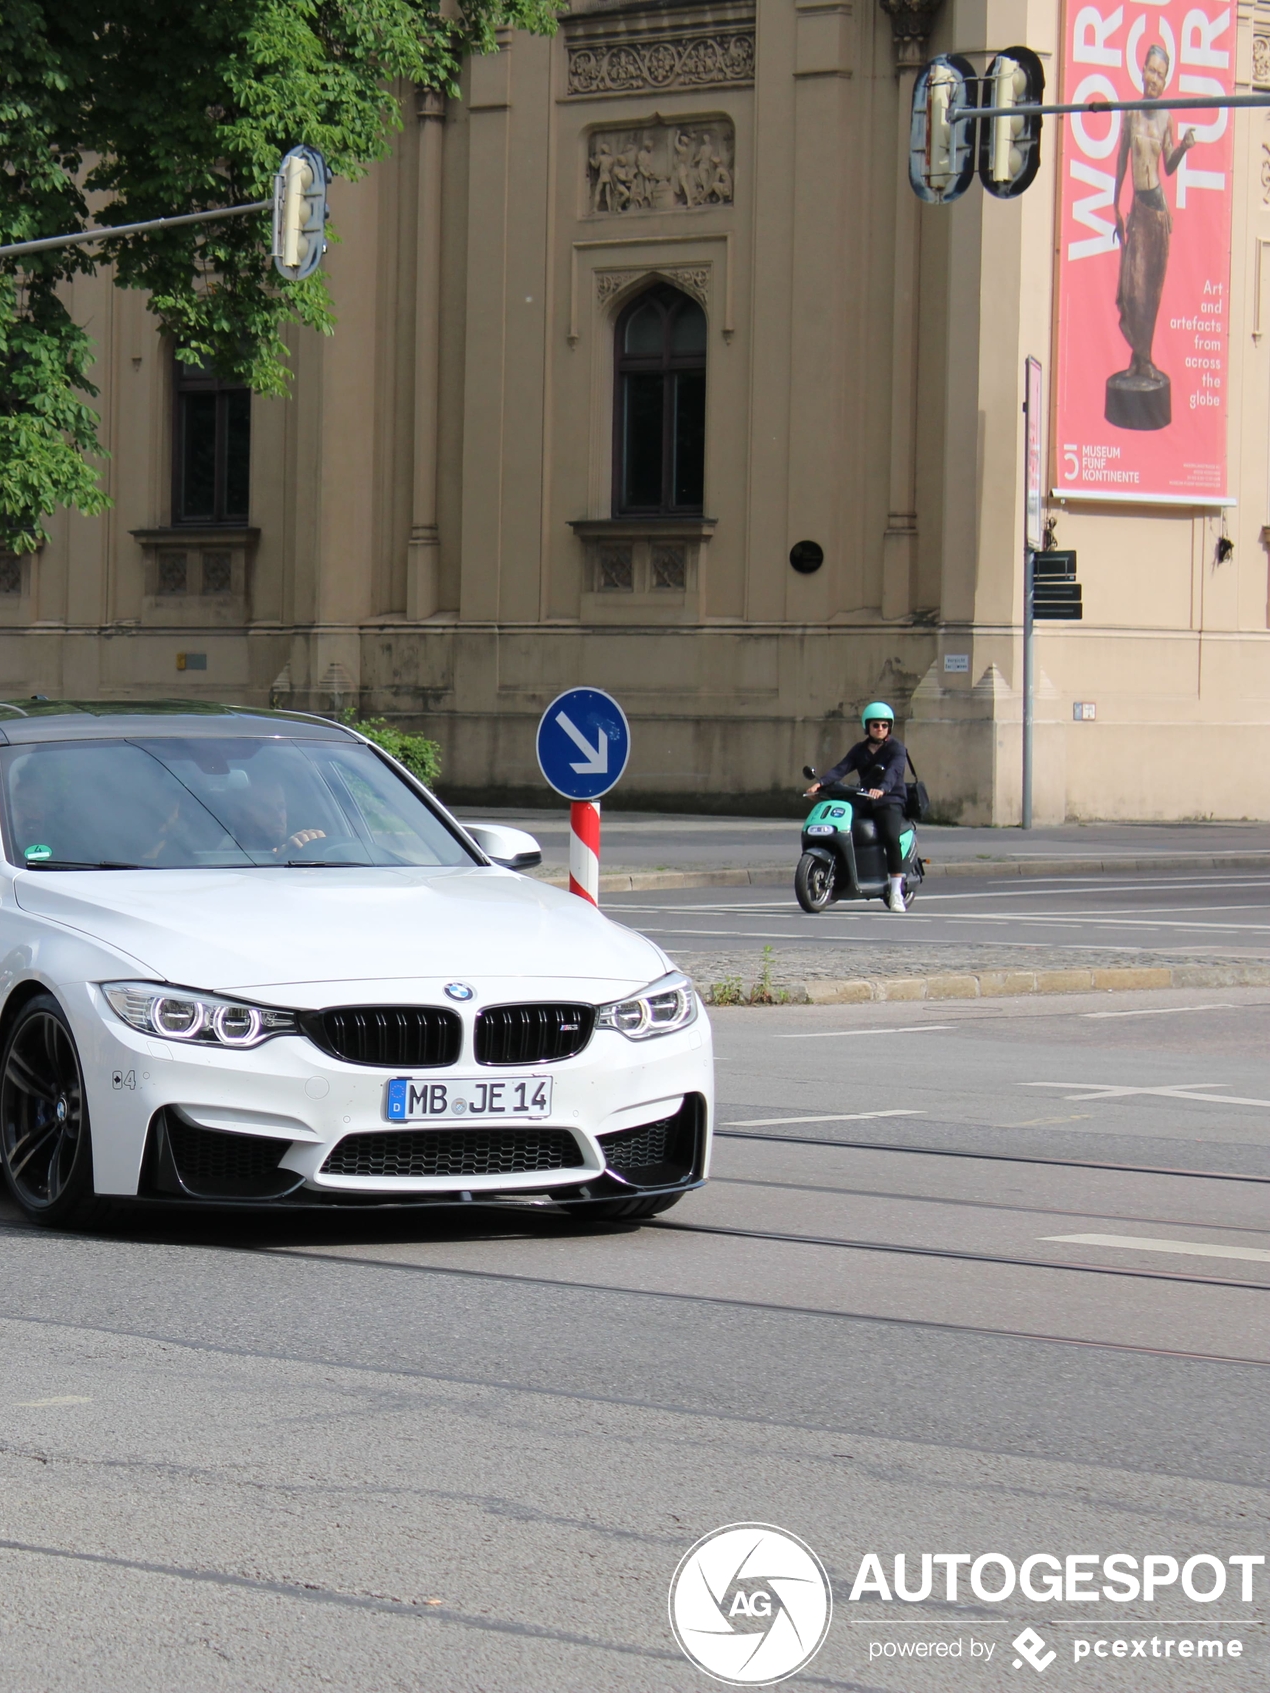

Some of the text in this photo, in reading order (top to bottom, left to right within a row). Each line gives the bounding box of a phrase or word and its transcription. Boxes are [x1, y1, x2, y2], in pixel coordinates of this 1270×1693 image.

[1126, 0, 1176, 97] C
[1203, 280, 1223, 295] Art
[1201, 299, 1222, 314] and
[1170, 316, 1221, 333] artefacts
[1194, 335, 1221, 351] from
[1185, 357, 1221, 370] across
[1202, 373, 1220, 388] the
[1189, 390, 1220, 409] globe
[1082, 444, 1121, 459] MUSEUM
[1082, 469, 1140, 484] KONTINENTE
[393, 1081, 547, 1114] D MB JE 14
